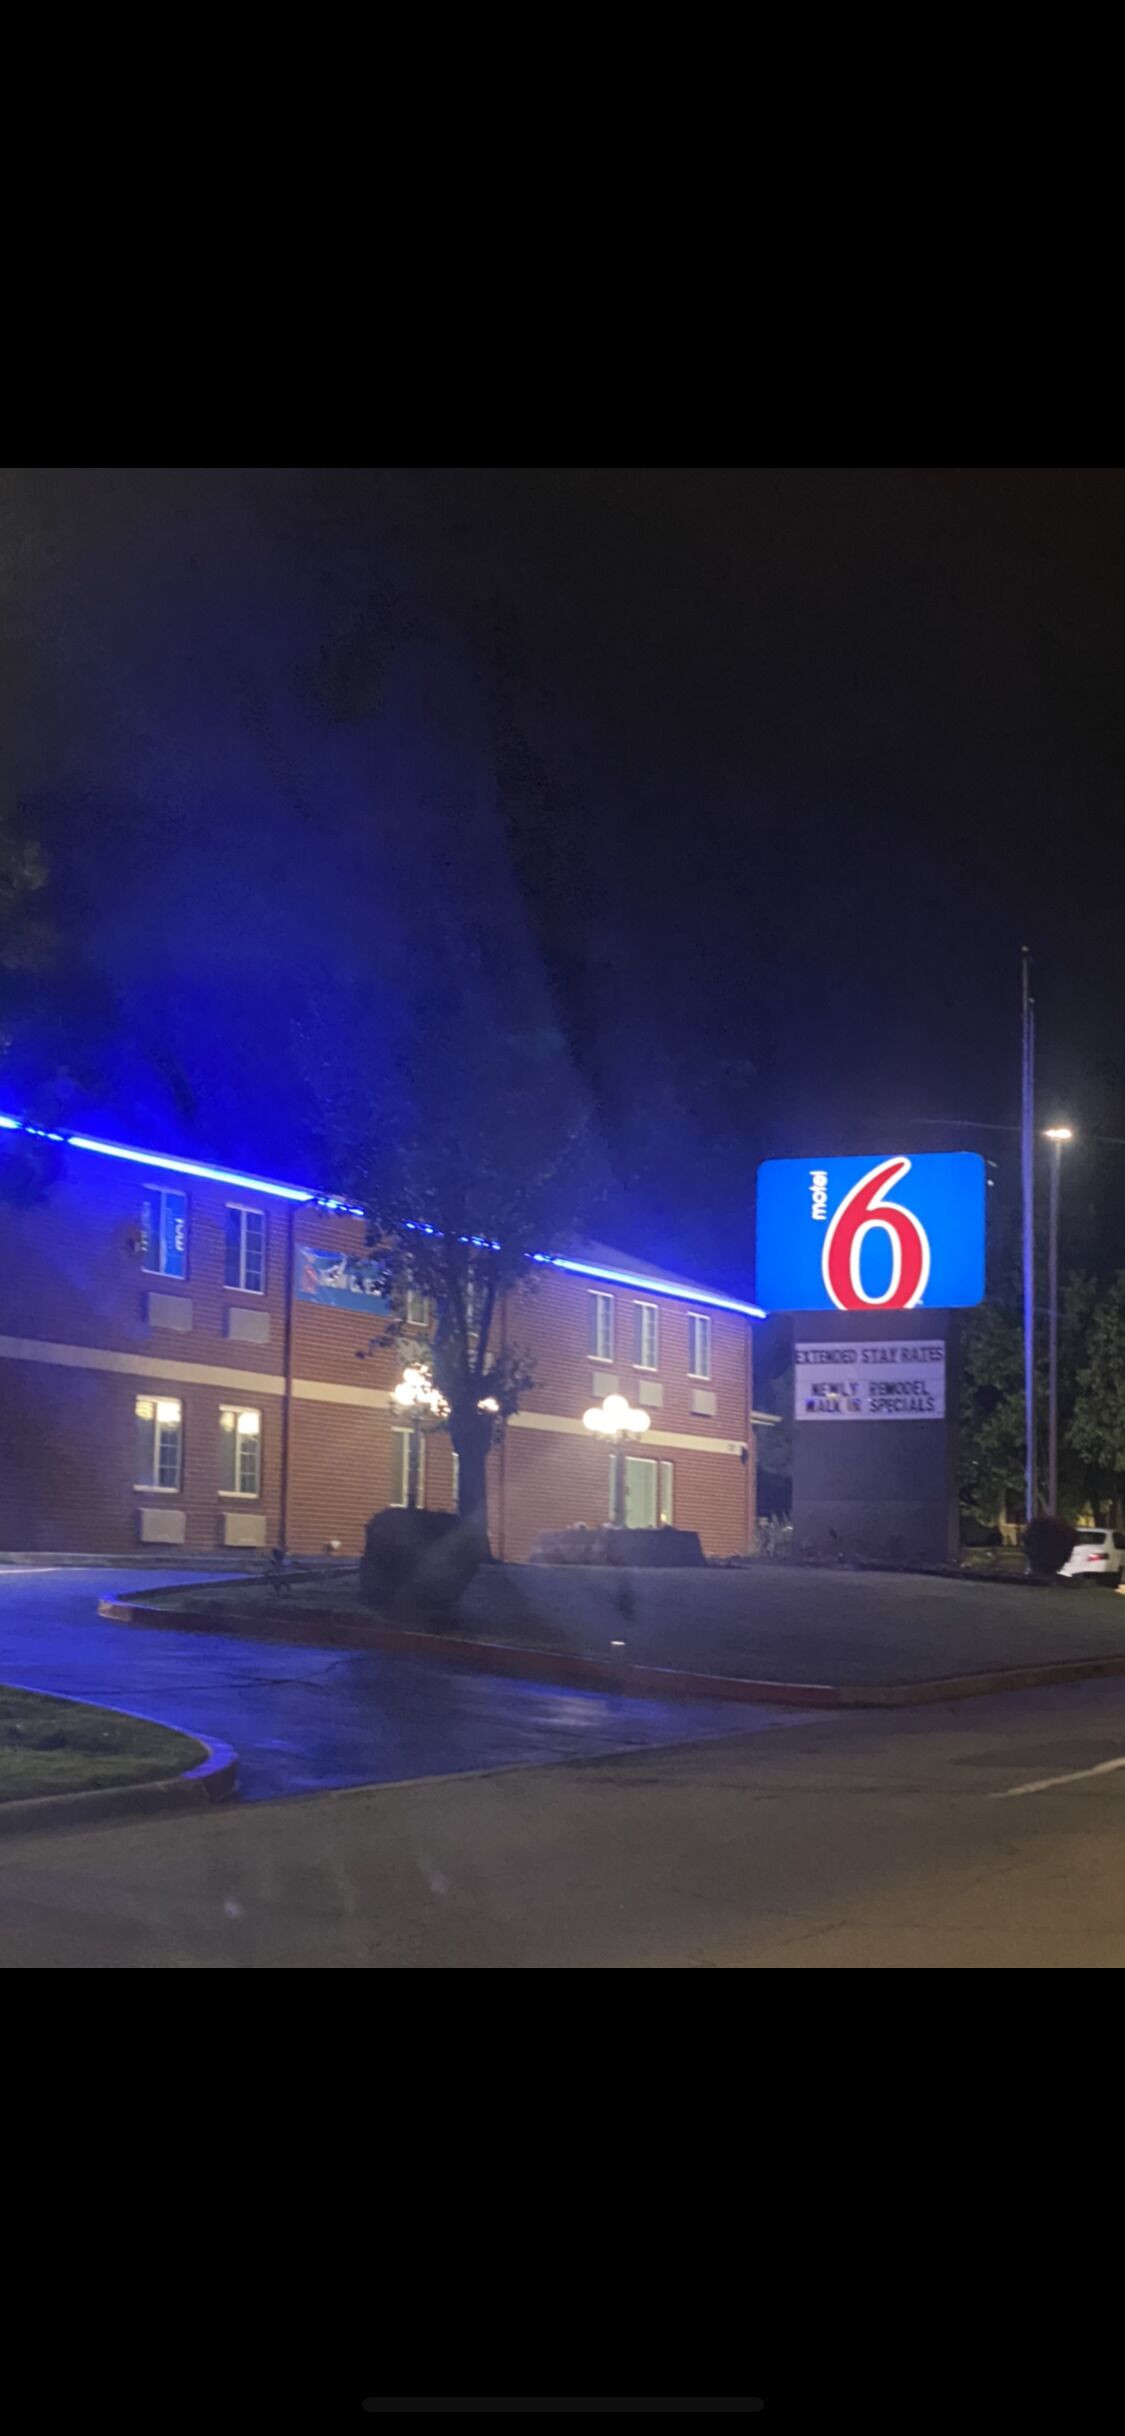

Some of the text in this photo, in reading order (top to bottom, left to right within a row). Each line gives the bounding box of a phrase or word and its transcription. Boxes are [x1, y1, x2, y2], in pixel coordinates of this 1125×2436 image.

[809, 1156, 930, 1309] motel 6
[796, 1347, 943, 1364] EXTENDED STAY RATES
[812, 1381, 930, 1396] NEWLY REMODEL
[806, 1398, 841, 1412] WALK
[869, 1397, 935, 1412] SPECIALS
